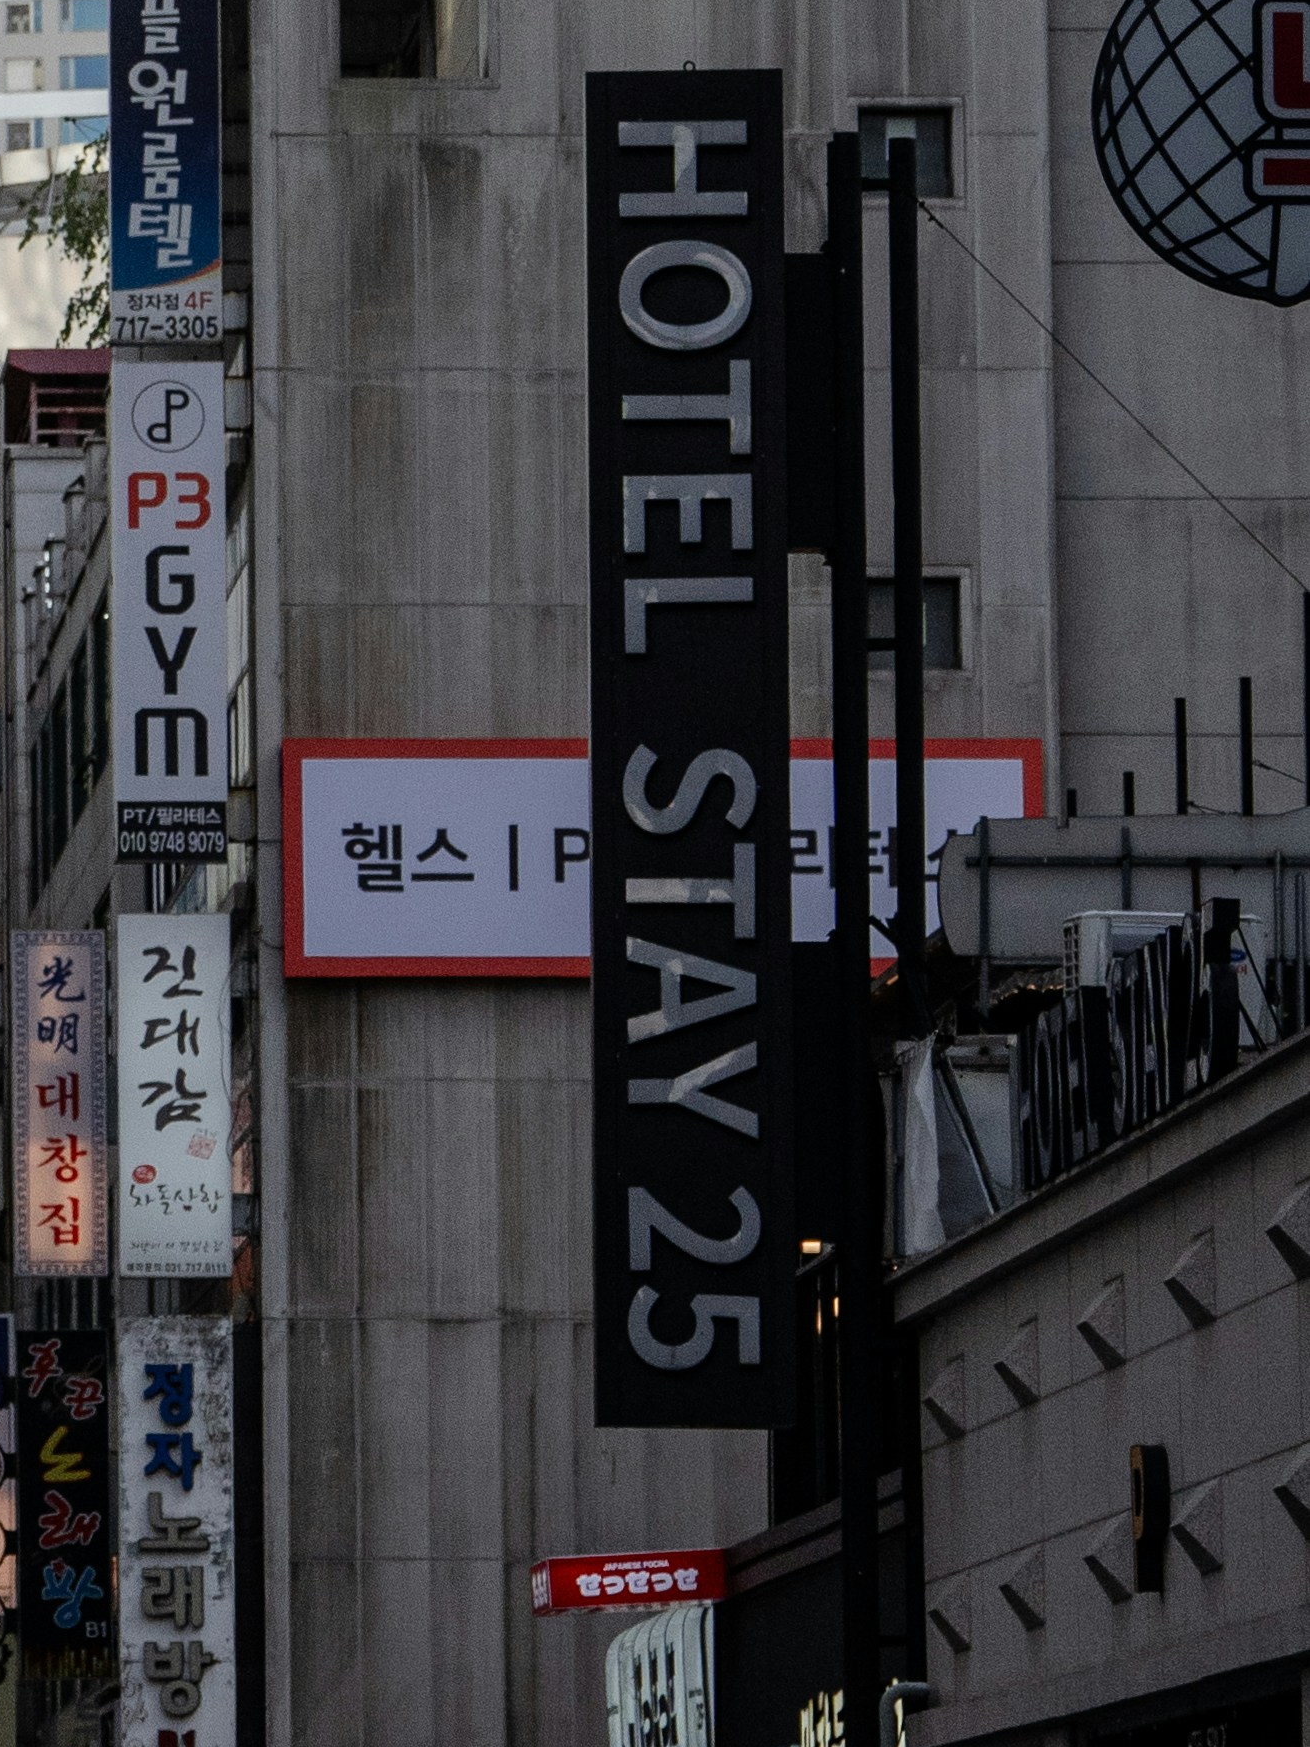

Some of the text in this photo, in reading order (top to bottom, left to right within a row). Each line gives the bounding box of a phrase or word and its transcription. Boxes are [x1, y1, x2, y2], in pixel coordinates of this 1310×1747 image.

[115, 317, 219, 340] 717-3305
[127, 291, 213, 310] 정자점 4F
[128, 472, 211, 778] P3 GYM
[617, 119, 763, 1372] HOTEL STAY 25
[120, 831, 225, 854] 010 9748 9079
[123, 806, 222, 826] PT/필라테스
[341, 822, 475, 892] 헬스
[139, 946, 207, 1130] 진대감
[37, 955, 87, 1245] 光明 대창집
